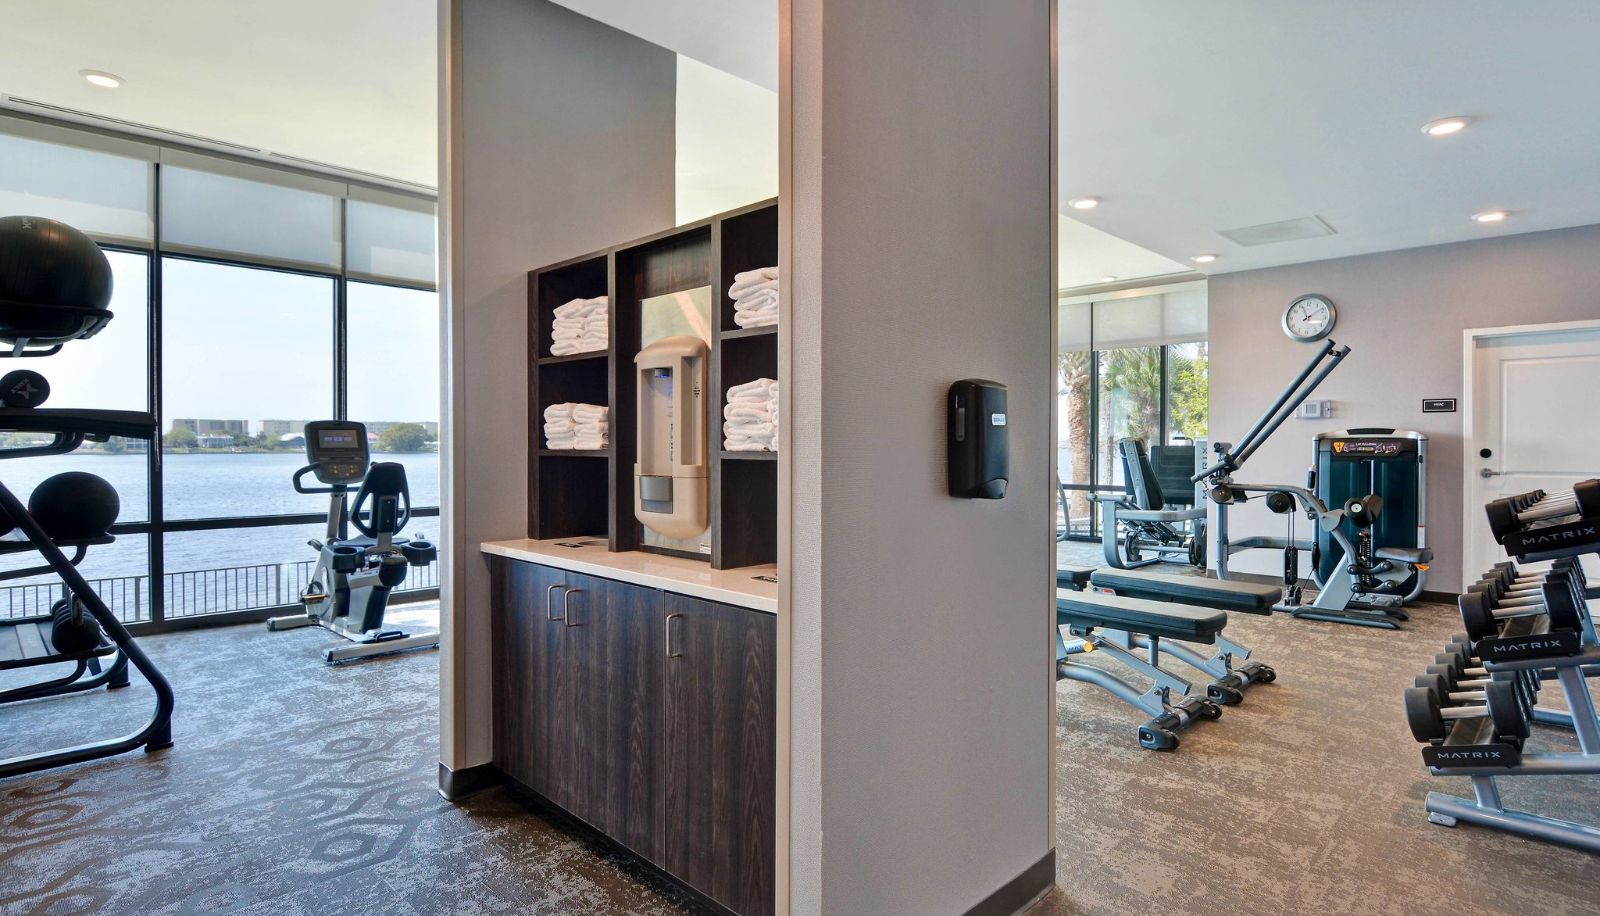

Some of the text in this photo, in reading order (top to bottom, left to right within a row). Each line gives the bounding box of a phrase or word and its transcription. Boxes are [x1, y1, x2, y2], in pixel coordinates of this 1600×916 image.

[1521, 527, 1596, 545] MATRIX
[1493, 640, 1561, 653] MATRIX
[1437, 751, 1501, 759] MATRIX
